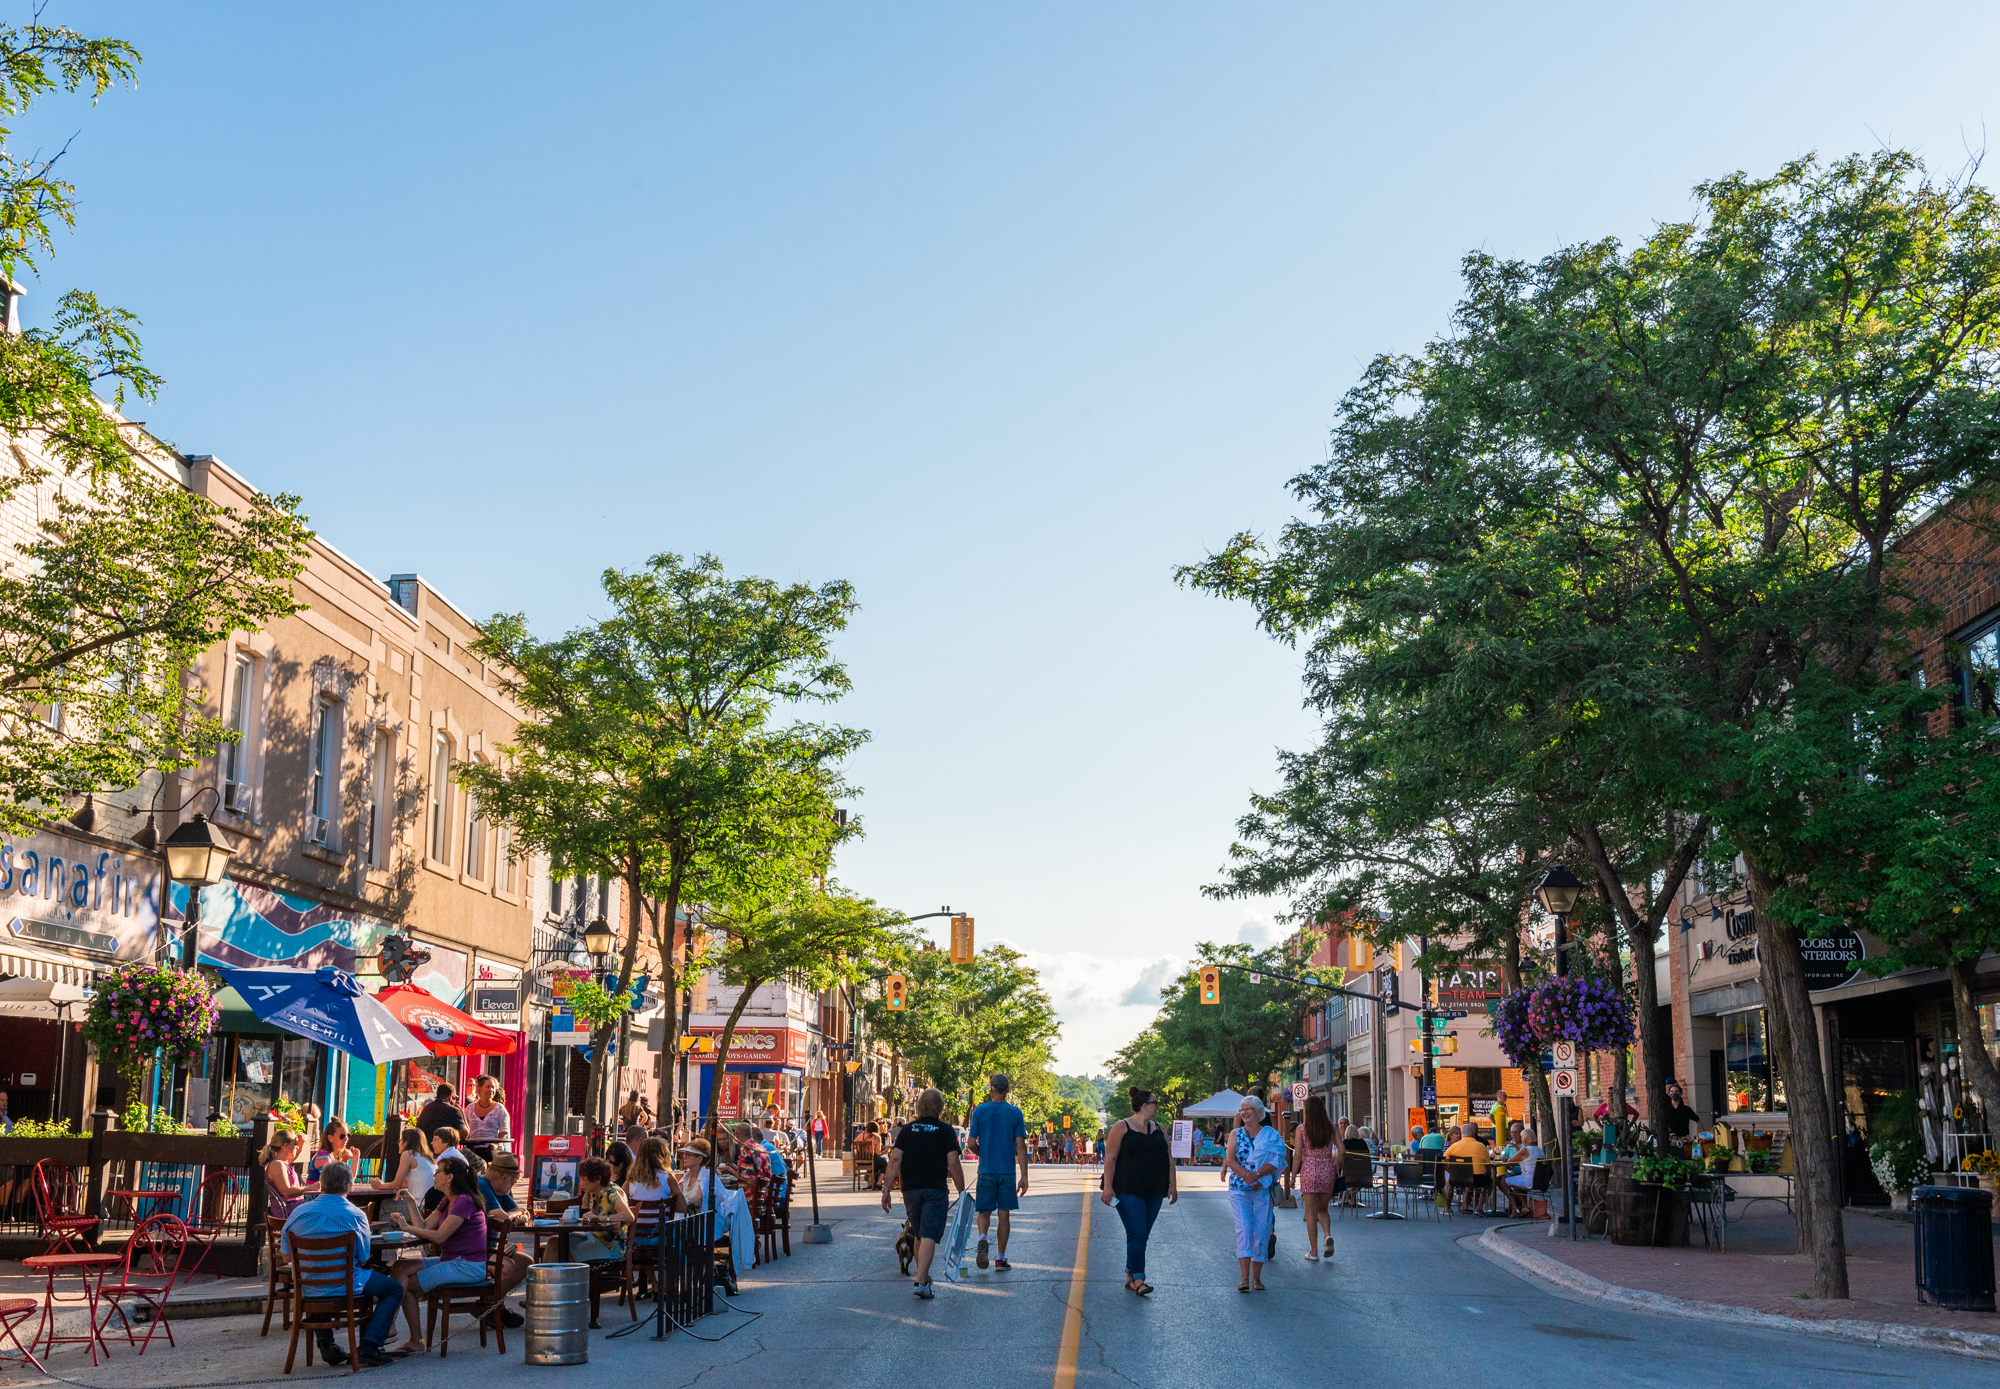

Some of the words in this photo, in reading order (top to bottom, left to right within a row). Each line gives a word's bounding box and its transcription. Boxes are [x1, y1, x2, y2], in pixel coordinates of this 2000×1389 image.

[0, 845, 138, 918] sanafir
[26, 922, 107, 948] CUISINE
[1838, 938, 1857, 949] UP
[1452, 990, 1486, 1000] TEAM
[481, 998, 515, 1010] Eleven
[289, 1015, 318, 1031] ACE
[324, 1028, 355, 1046] HILL
[147, 1169, 193, 1179] Curbside
[147, 1182, 181, 1194] Pickup
